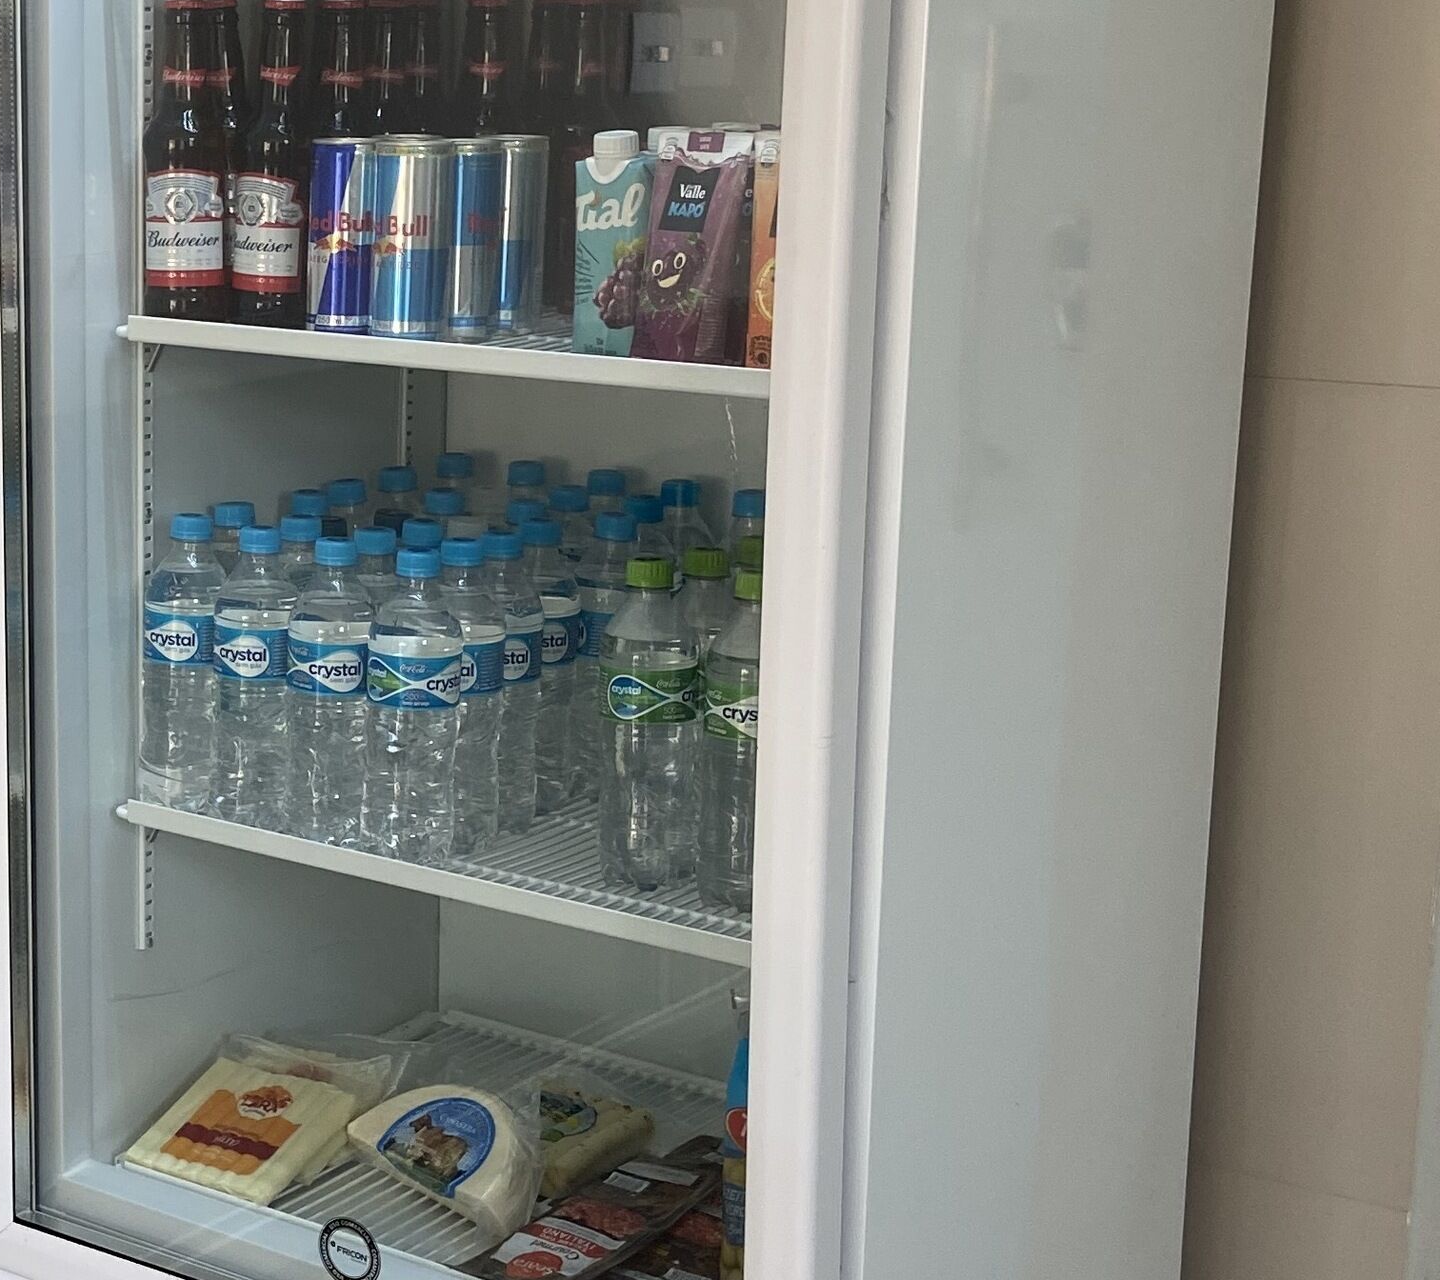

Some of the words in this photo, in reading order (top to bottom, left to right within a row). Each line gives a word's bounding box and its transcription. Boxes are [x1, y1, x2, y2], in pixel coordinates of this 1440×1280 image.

[679, 183, 706, 200] Valle
[667, 201, 705, 218] KAPÓ
[310, 210, 336, 230] ed
[388, 215, 428, 236] Bull
[147, 230, 220, 249] Budweiser
[150, 631, 196, 647] crystal
[541, 632, 567, 648] stal
[219, 647, 267, 663] crystal
[504, 650, 529, 665] stal
[308, 661, 362, 679] crystal
[612, 684, 642, 696] crystal
[722, 706, 758, 723] crys
[336, 1245, 368, 1262] FRICON
